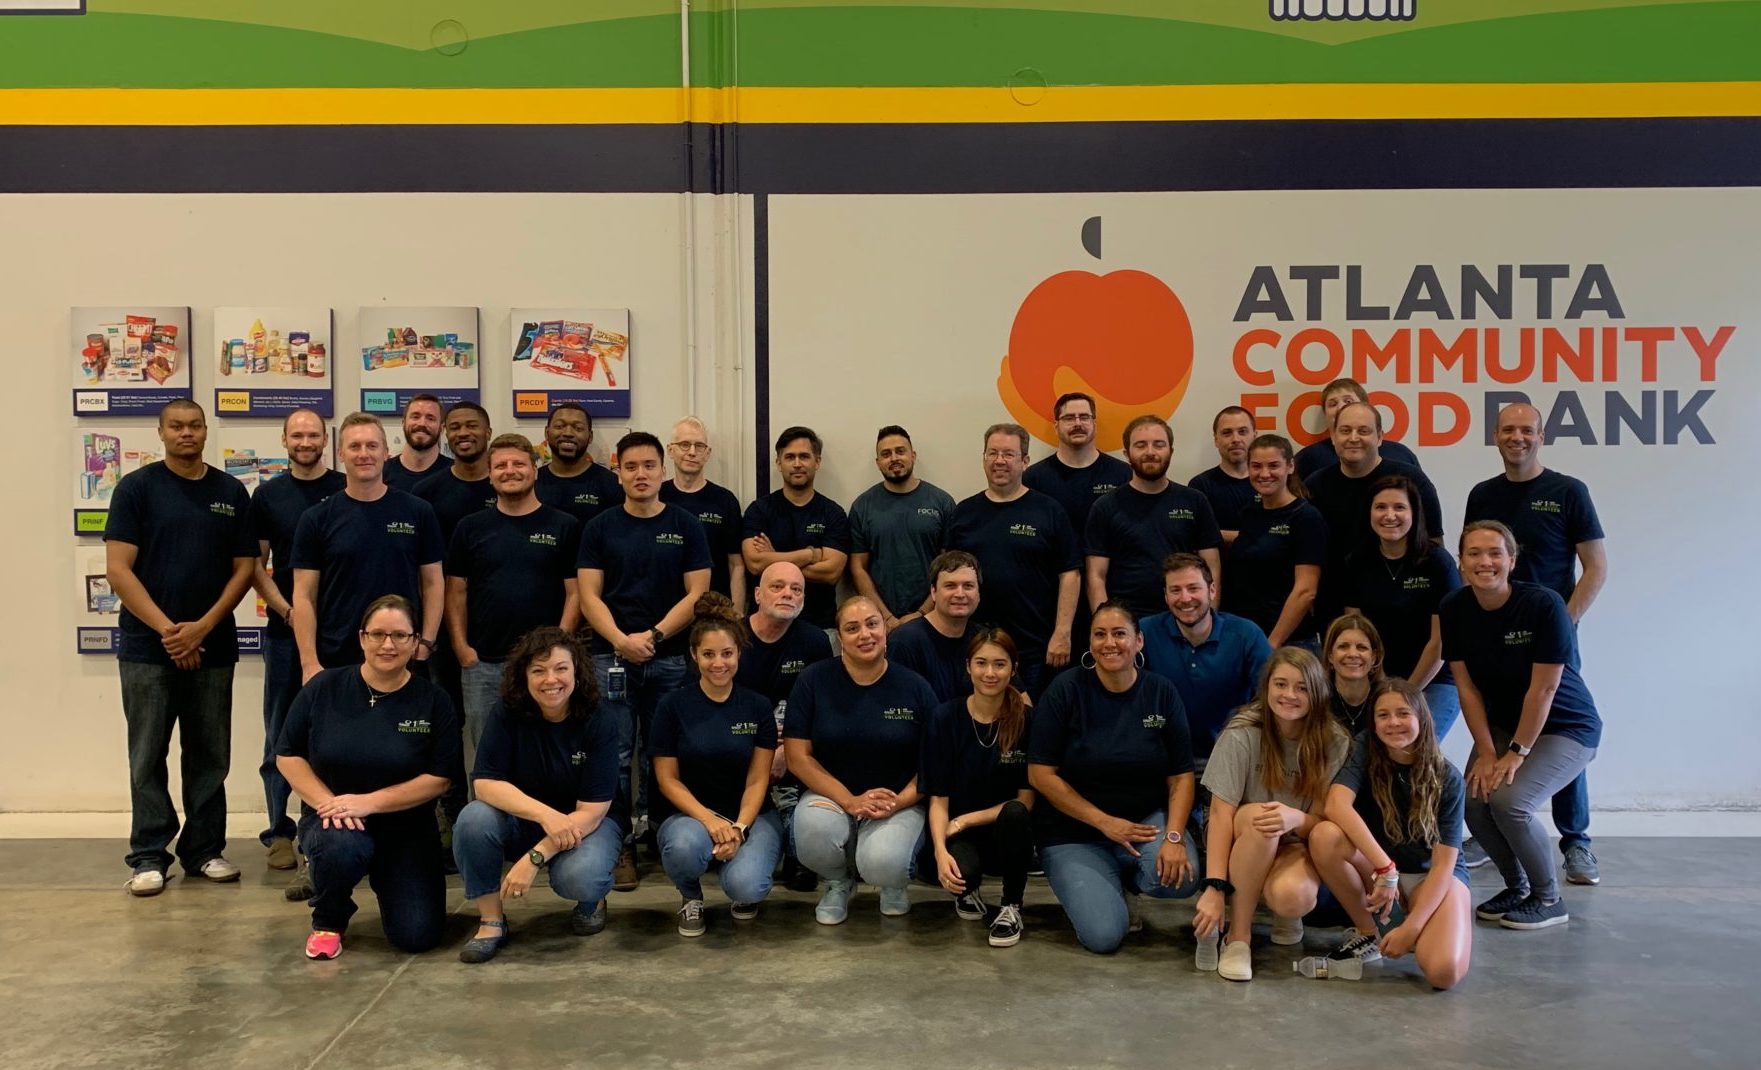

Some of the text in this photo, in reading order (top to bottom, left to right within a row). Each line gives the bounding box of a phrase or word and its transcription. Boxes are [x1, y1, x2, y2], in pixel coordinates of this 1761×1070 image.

[1233, 263, 1626, 322] ATLANTA
[1232, 326, 1737, 386] COMMUNITY
[397, 726, 431, 734] VOLUNTEER
